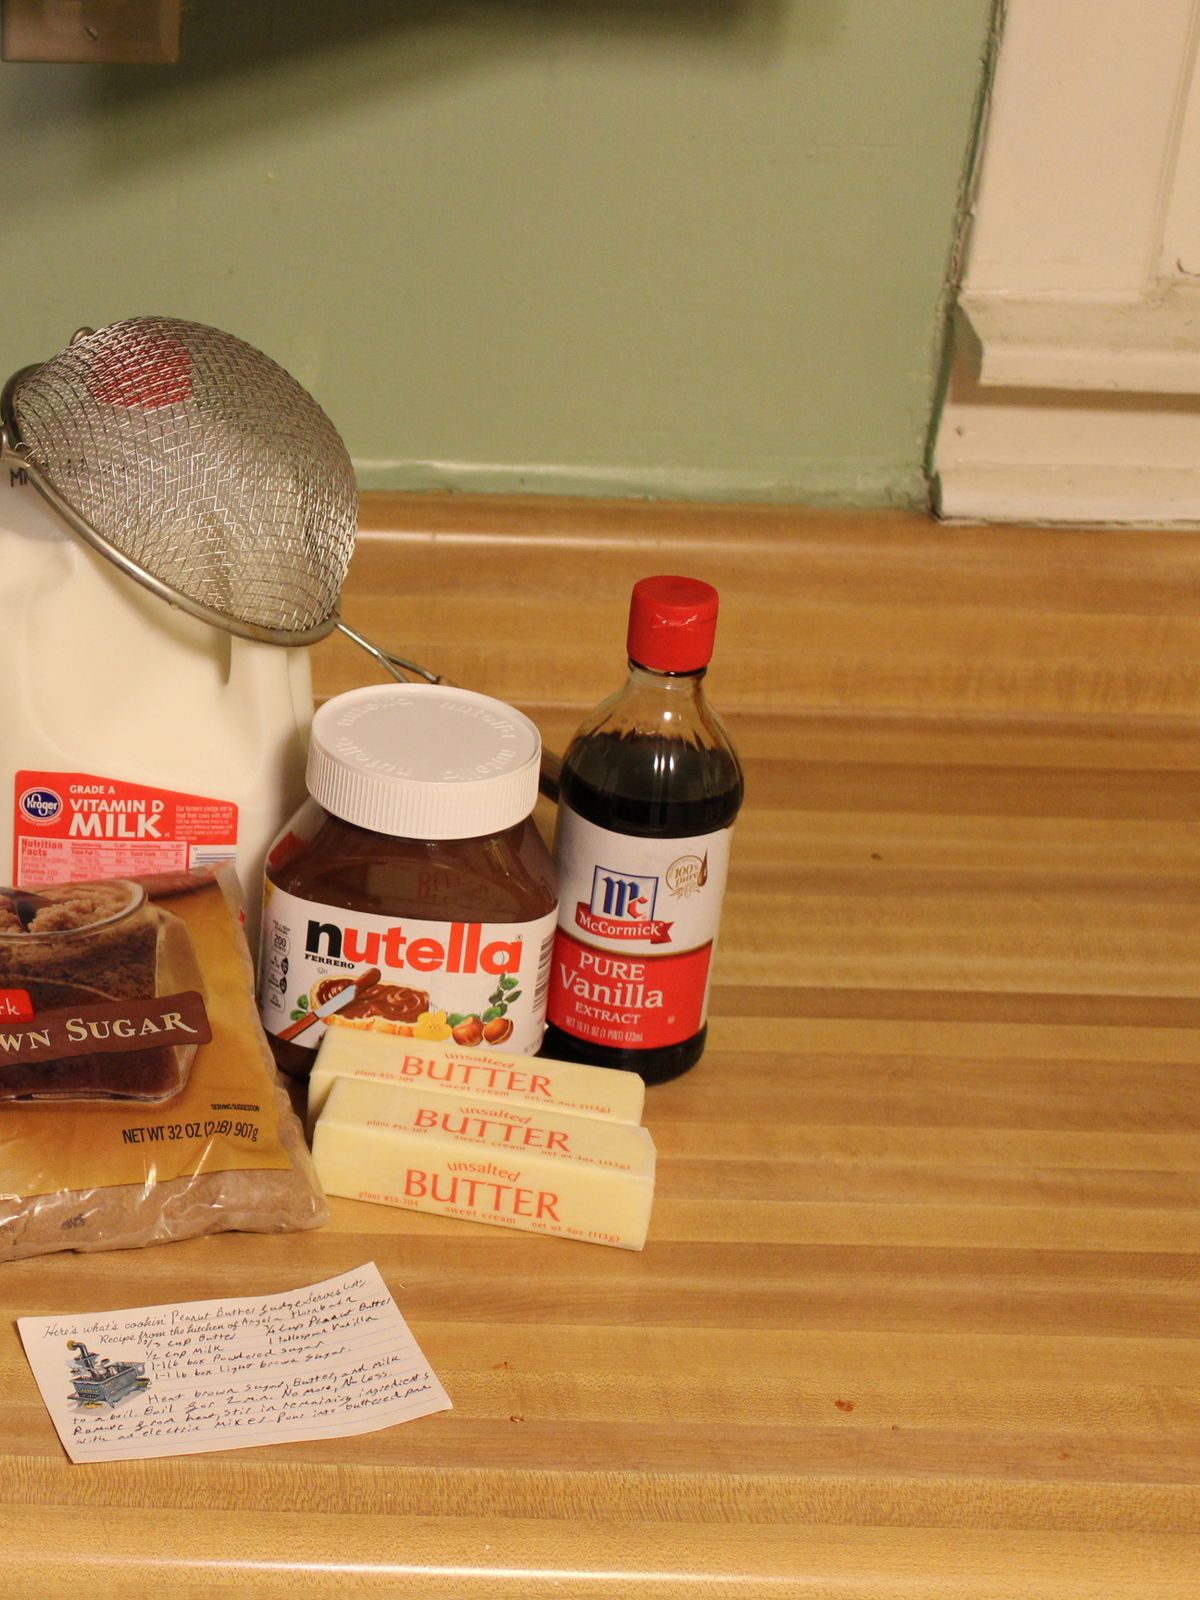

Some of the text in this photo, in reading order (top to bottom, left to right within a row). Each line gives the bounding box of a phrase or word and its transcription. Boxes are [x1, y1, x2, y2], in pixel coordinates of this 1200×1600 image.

[69, 785, 116, 795] GRADE A
[27, 793, 58, 816] Kroger
[69, 798, 146, 813] VITAMIN
[151, 799, 165, 813] D
[68, 813, 162, 838] MILK
[579, 911, 661, 936] McCormick
[305, 919, 523, 975] nutella
[304, 954, 355, 970] FERRERO
[579, 951, 645, 981] PURE
[559, 962, 664, 1009] Vanilla
[575, 1002, 642, 1025] EXTRACT
[65, 1012, 198, 1043] SUGAR
[444, 1053, 515, 1069] unsalted
[400, 1055, 553, 1097] BUTTER
[459, 1107, 532, 1124] unsalted
[122, 1127, 145, 1144] NET
[148, 1126, 165, 1142] WT
[167, 1124, 183, 1140] 32
[185, 1123, 202, 1138] OZ
[233, 1122, 259, 1142] 907g
[414, 1108, 570, 1152] BUTTER
[447, 1161, 521, 1182] unsalted
[359, 1191, 380, 1199] plant
[445, 1206, 477, 1217] sweet
[482, 1210, 516, 1223] cream
[404, 1168, 560, 1222] BUTTER
[42, 1322, 77, 1339] Here's
[83, 1321, 118, 1334] what's
[125, 1314, 167, 1330] cookin'
[99, 1333, 135, 1345] Recipe
[136, 1330, 166, 1345] from
[170, 1326, 184, 1336] the
[187, 1322, 224, 1335] kitchen
[227, 1321, 239, 1331] of
